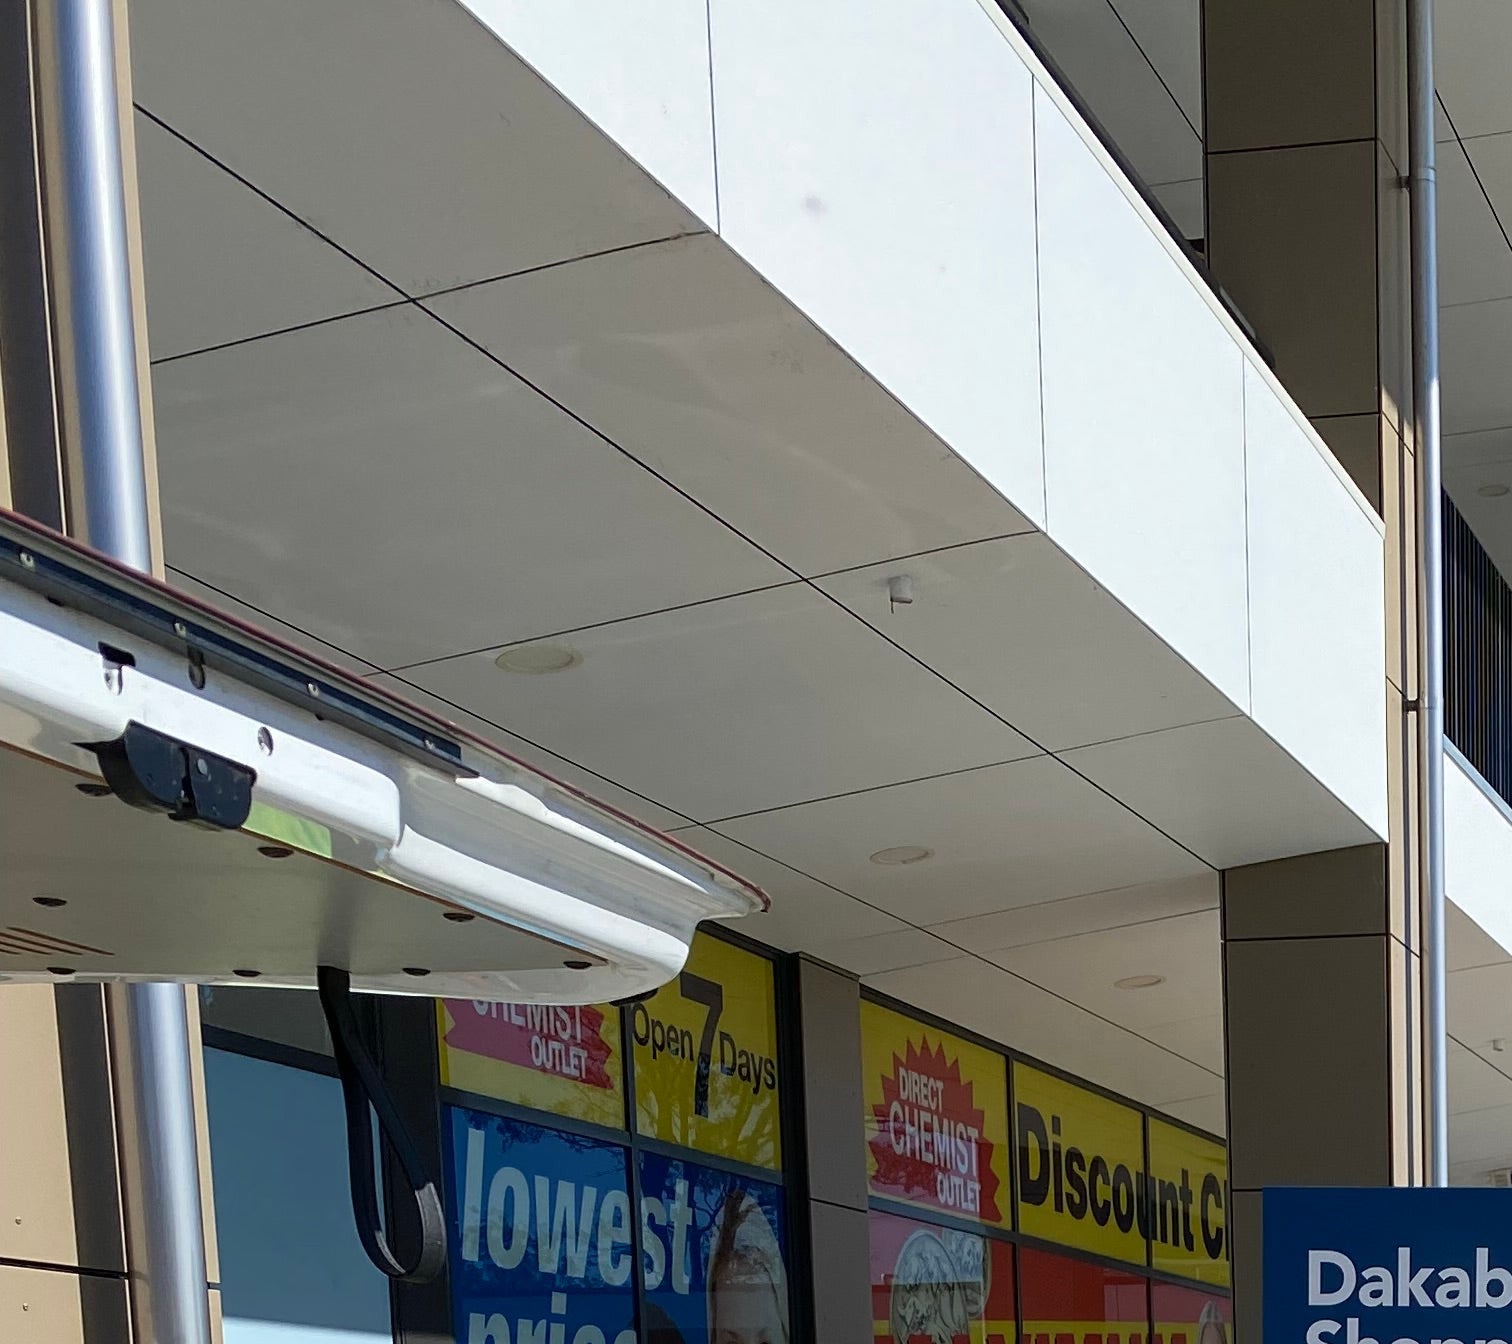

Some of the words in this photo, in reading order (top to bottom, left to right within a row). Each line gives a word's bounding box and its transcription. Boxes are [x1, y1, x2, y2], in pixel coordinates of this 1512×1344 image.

[530, 1034, 588, 1079] OUTLET
[632, 1005, 694, 1062] Open
[679, 971, 723, 1118] 7
[719, 1031, 777, 1094] Days
[899, 1066, 944, 1113] DIRECT
[889, 1100, 980, 1177] CHEMIST
[1017, 1101, 1195, 1253] Discount
[462, 1127, 692, 1295] lowest
[936, 1170, 981, 1213] OUTLET
